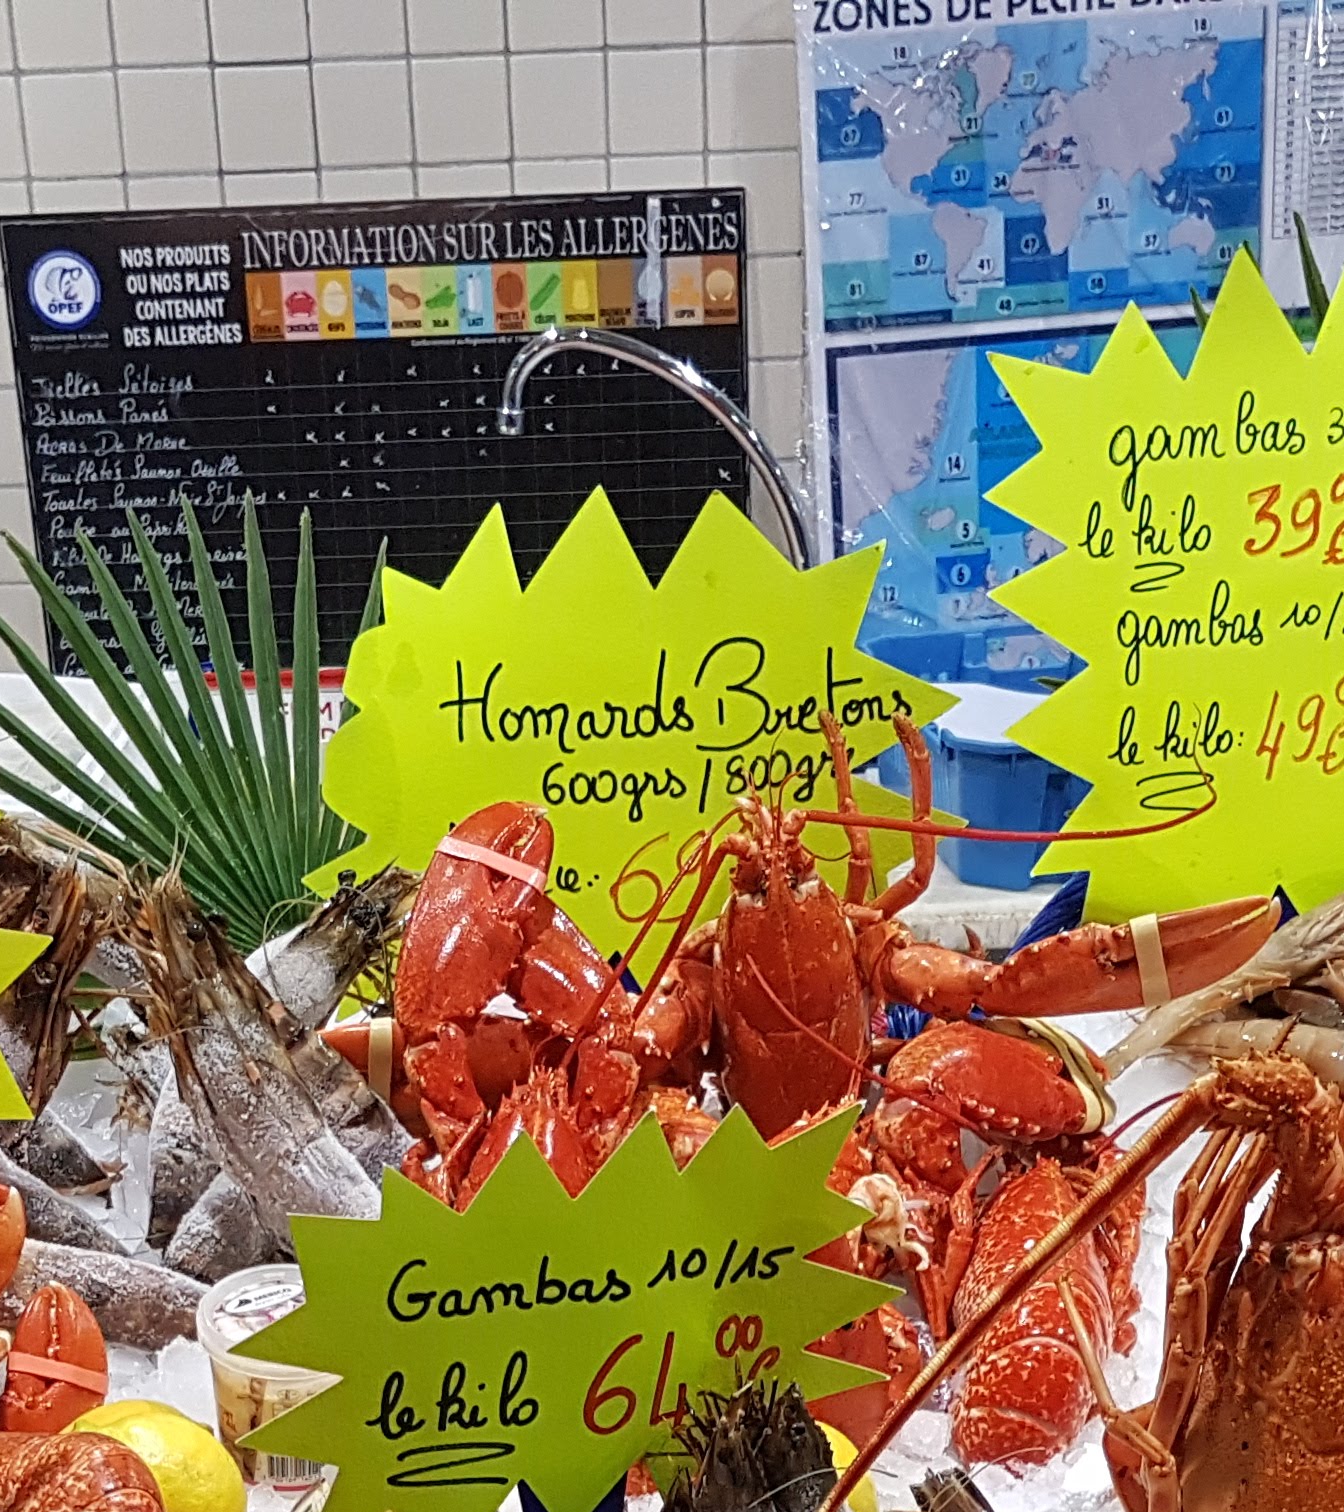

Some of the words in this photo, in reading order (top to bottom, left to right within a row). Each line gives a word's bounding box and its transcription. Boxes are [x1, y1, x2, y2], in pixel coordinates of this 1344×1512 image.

[813, 0, 932, 33] ZONES
[120, 248, 153, 269] NOS
[156, 244, 231, 266] PRODUITS
[242, 222, 439, 270] INFORMATION
[443, 221, 498, 261] SUR
[503, 219, 554, 259] LES
[126, 276, 150, 295] OU
[151, 274, 183, 294] NOS
[185, 271, 231, 292] PLATS
[48, 301, 83, 314] OPEF
[134, 298, 226, 321] CONTENANT
[123, 325, 151, 348] DES
[153, 321, 243, 347] ALLERGÈNES
[947, 456, 961, 472] 14
[1108, 390, 1306, 512] gambas
[960, 522, 970, 537] 5
[1078, 500, 1114, 559] le
[1131, 493, 1213, 555] kilo
[1243, 483, 1323, 559] 39
[956, 567, 966, 582] 6
[1116, 579, 1265, 687] gambas
[440, 648, 696, 754] Homards
[694, 637, 913, 752] Bretons
[1107, 704, 1144, 766] le
[1255, 690, 1325, 782] 49
[388, 1255, 633, 1323] Gambas
[647, 1238, 796, 1291] 10/15
[364, 1371, 426, 1441] le
[436, 1350, 540, 1433] kilo
